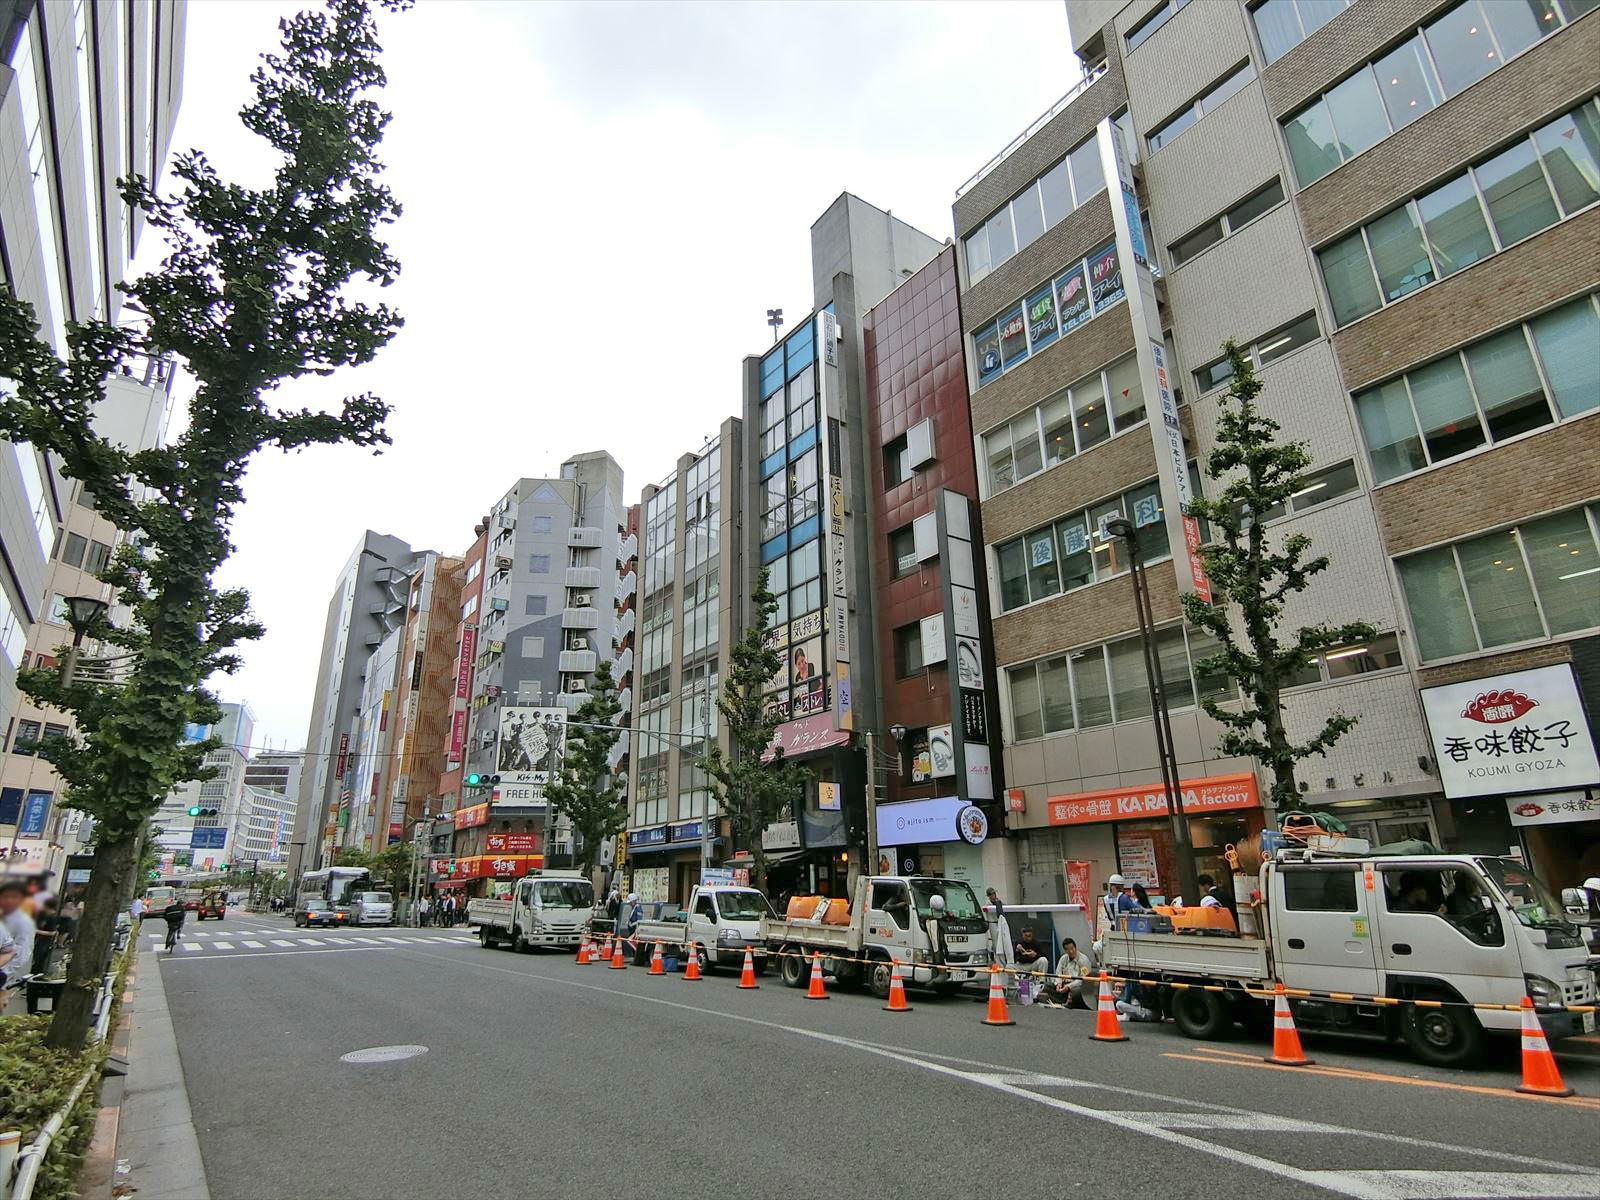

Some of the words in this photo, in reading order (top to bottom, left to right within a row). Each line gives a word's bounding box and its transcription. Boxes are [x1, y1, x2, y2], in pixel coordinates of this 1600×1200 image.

[1093, 257, 1115, 279] 仲介
[1153, 345, 1173, 414] 後藤歯科医院
[463, 635, 472, 668] Reverse
[459, 669, 470, 694] Alpha
[1482, 704, 1516, 721] 香味
[790, 729, 829, 748] ガランス
[1443, 720, 1578, 763] 香味餃子
[1467, 764, 1511, 778] KOUMI
[1515, 758, 1566, 773] GYOZA
[506, 789, 530, 798] FREE
[1201, 785, 1248, 795] カラダファクトリー
[1202, 792, 1249, 805] factory
[27, 796, 44, 831] 共栄ビル
[907, 817, 922, 826] ajito
[492, 856, 517, 872] すき家
